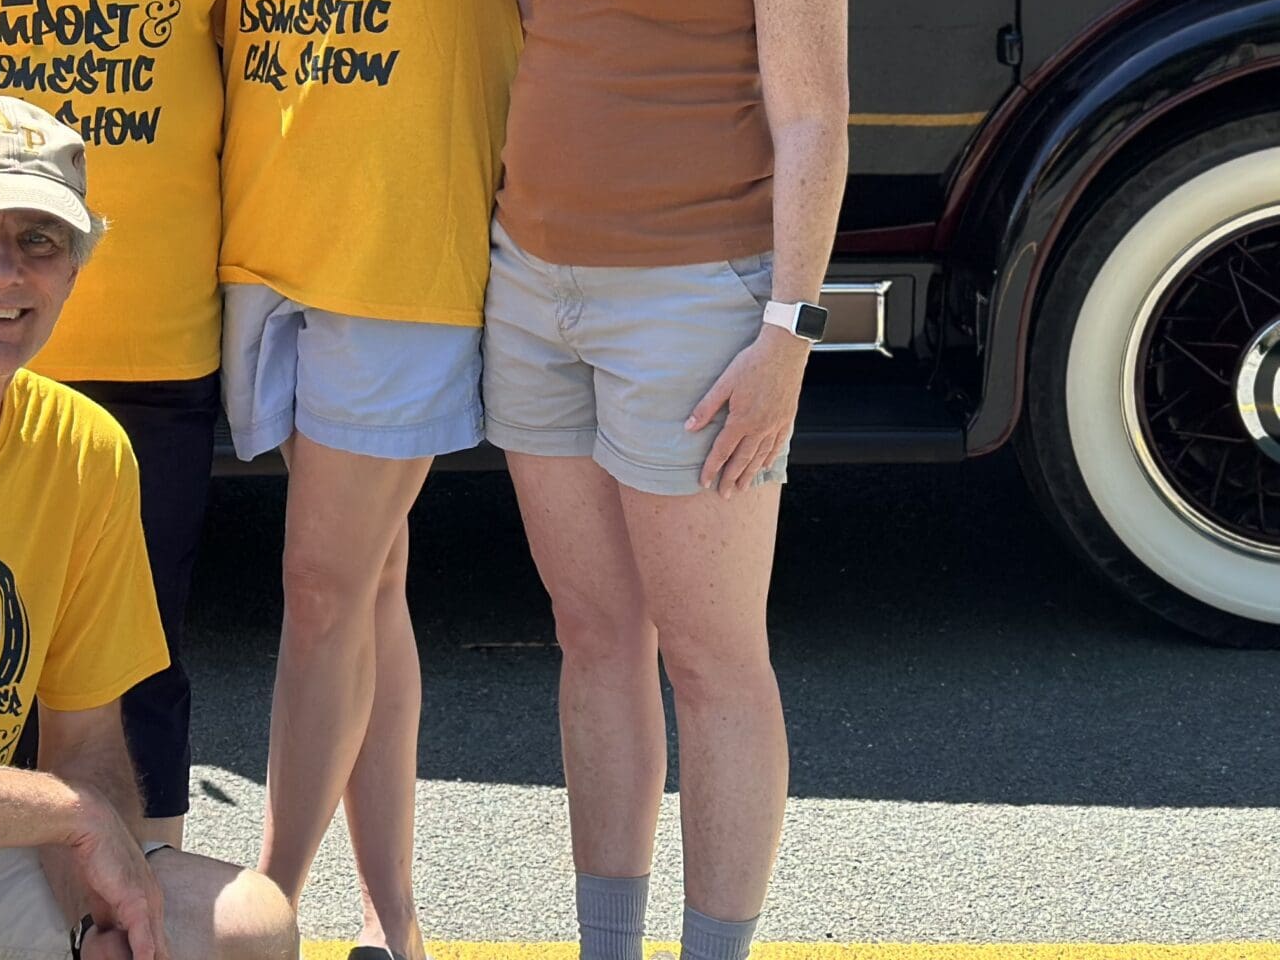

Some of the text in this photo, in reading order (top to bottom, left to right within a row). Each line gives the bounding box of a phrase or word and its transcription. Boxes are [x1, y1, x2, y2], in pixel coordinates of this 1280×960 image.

[139, 0, 181, 48] &
[244, 40, 400, 91] CAR SHOW
